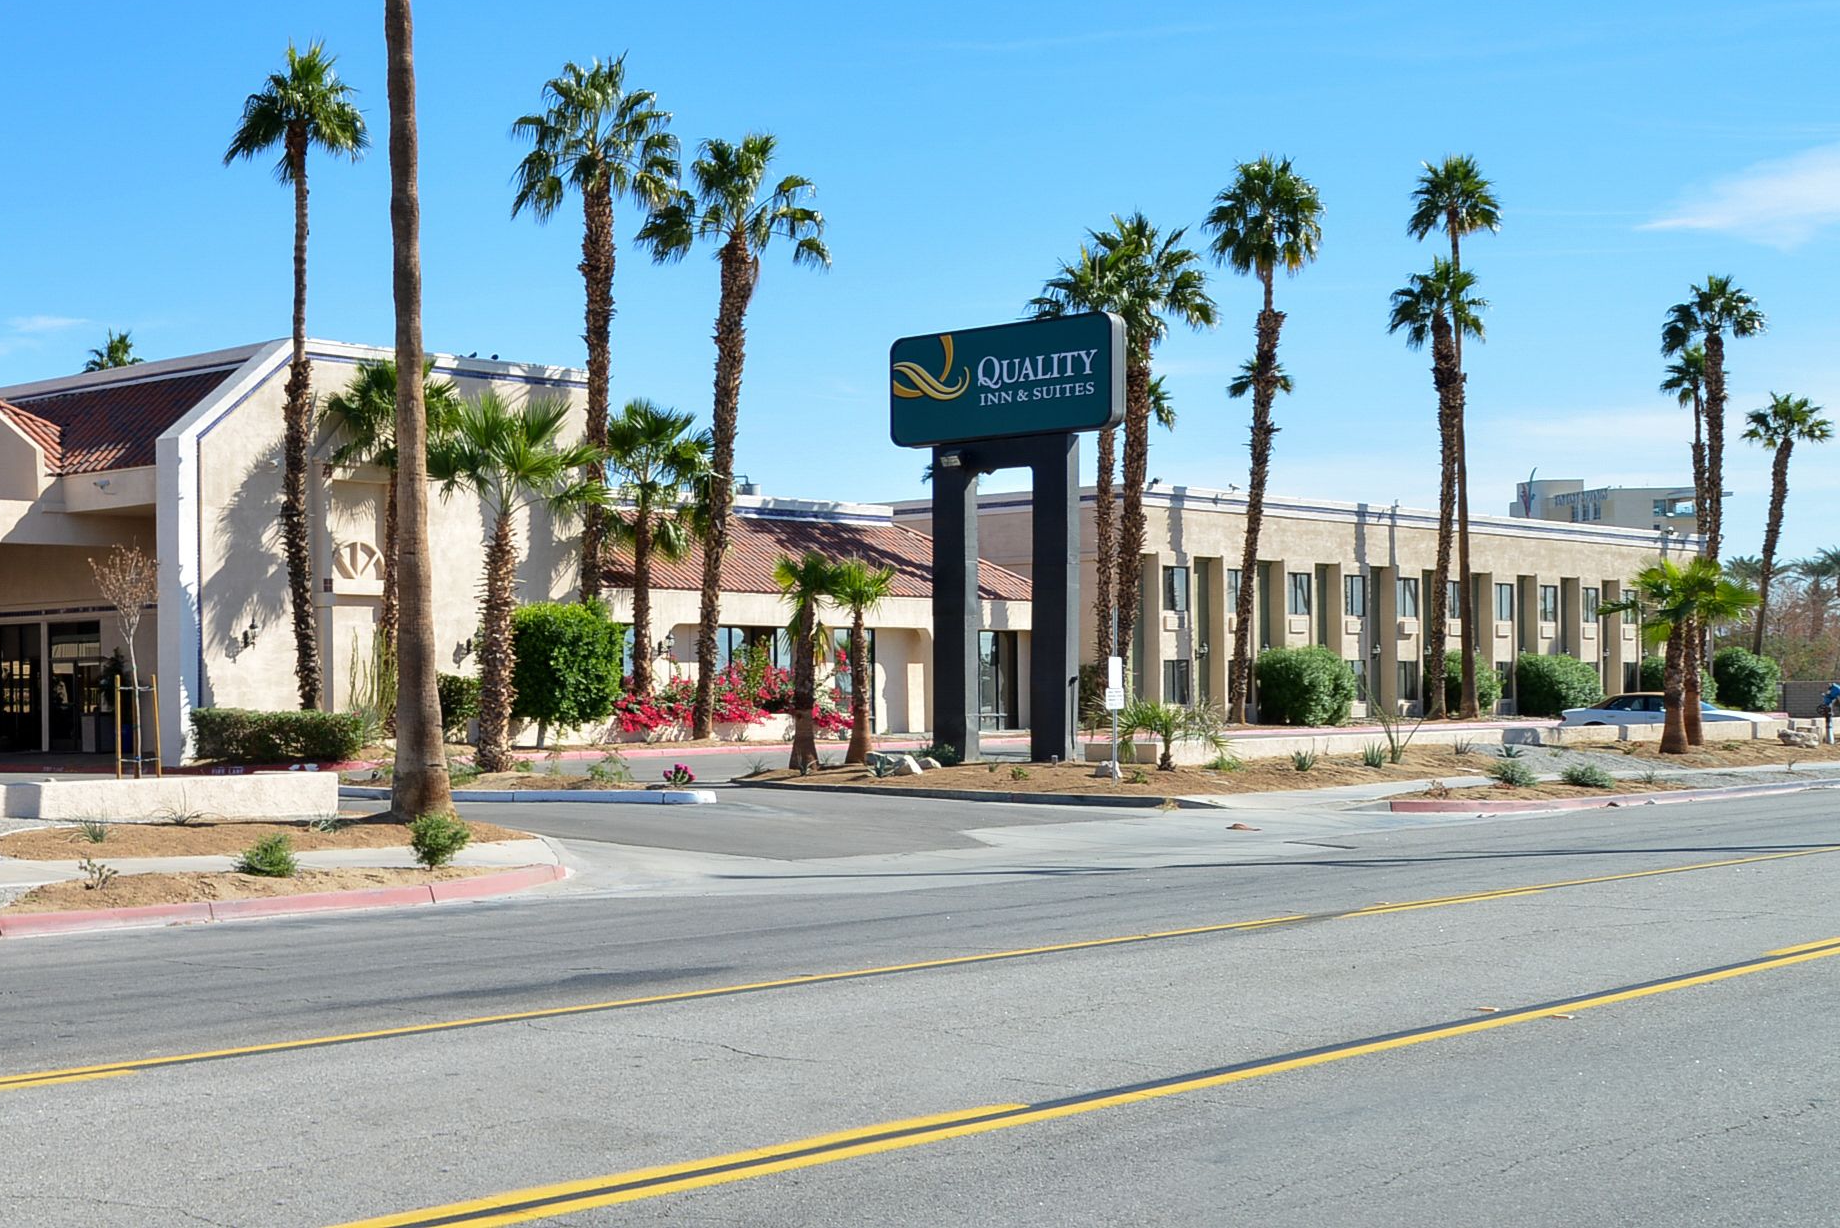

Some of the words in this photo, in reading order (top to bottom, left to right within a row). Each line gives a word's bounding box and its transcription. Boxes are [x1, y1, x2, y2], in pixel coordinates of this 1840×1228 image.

[977, 349, 1098, 389] QUALITY
[979, 390, 1013, 406] INN
[1017, 389, 1029, 402] &
[1033, 381, 1095, 399] SUITES
